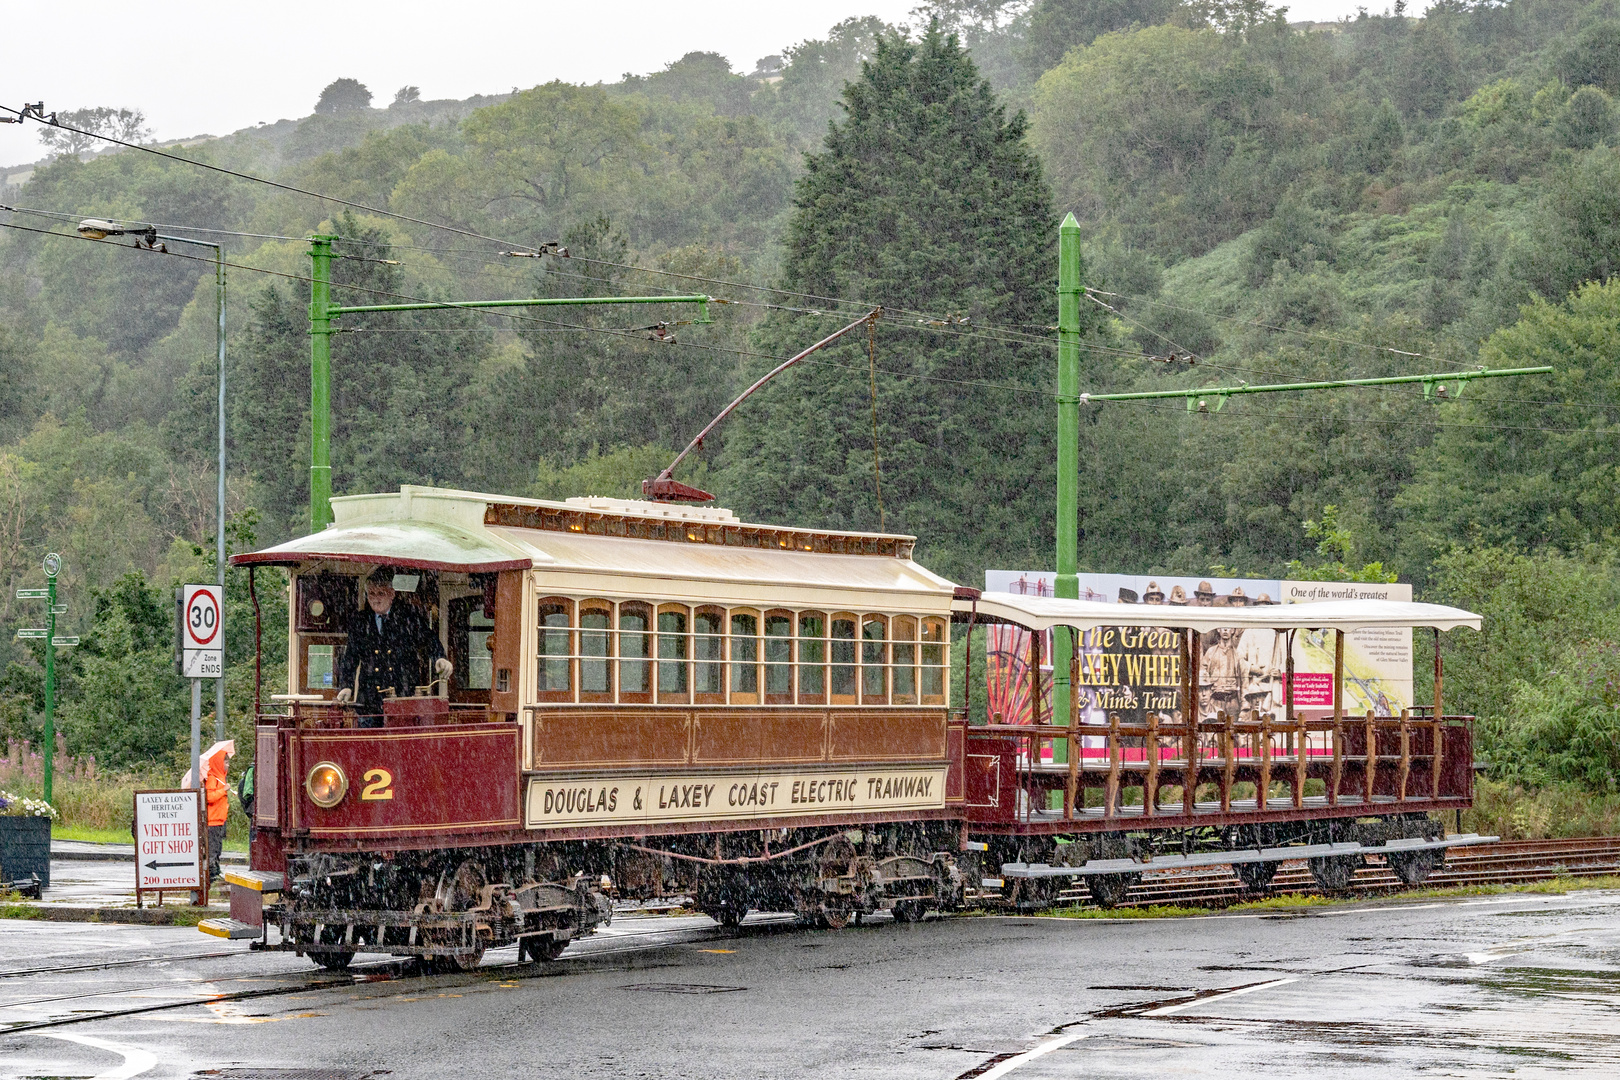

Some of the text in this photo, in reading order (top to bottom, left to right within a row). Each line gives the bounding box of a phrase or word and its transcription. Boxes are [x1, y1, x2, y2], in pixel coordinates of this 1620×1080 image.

[1290, 586, 1388, 600] One of the world's greatest
[191, 606, 215, 628] 30
[1120, 626, 1180, 649] Great
[204, 654, 217, 662] Zone
[201, 664, 220, 674] ENDS
[1125, 653, 1191, 687] WHEE
[1078, 691, 1178, 709] & Mines Trail
[360, 766, 395, 801] 2
[170, 795, 192, 803] LONAN
[543, 786, 619, 814] DOUGLAS
[633, 786, 643, 811] &
[658, 783, 716, 810] LAXEY
[728, 782, 779, 806] COAST
[791, 779, 858, 804] ELECTRIC
[151, 803, 184, 811] HERITAGE
[158, 811, 178, 819] TRUST
[143, 822, 191, 837] VISIT THE
[142, 840, 194, 854] GIFT SHOP
[143, 876, 196, 885] 200 metres
